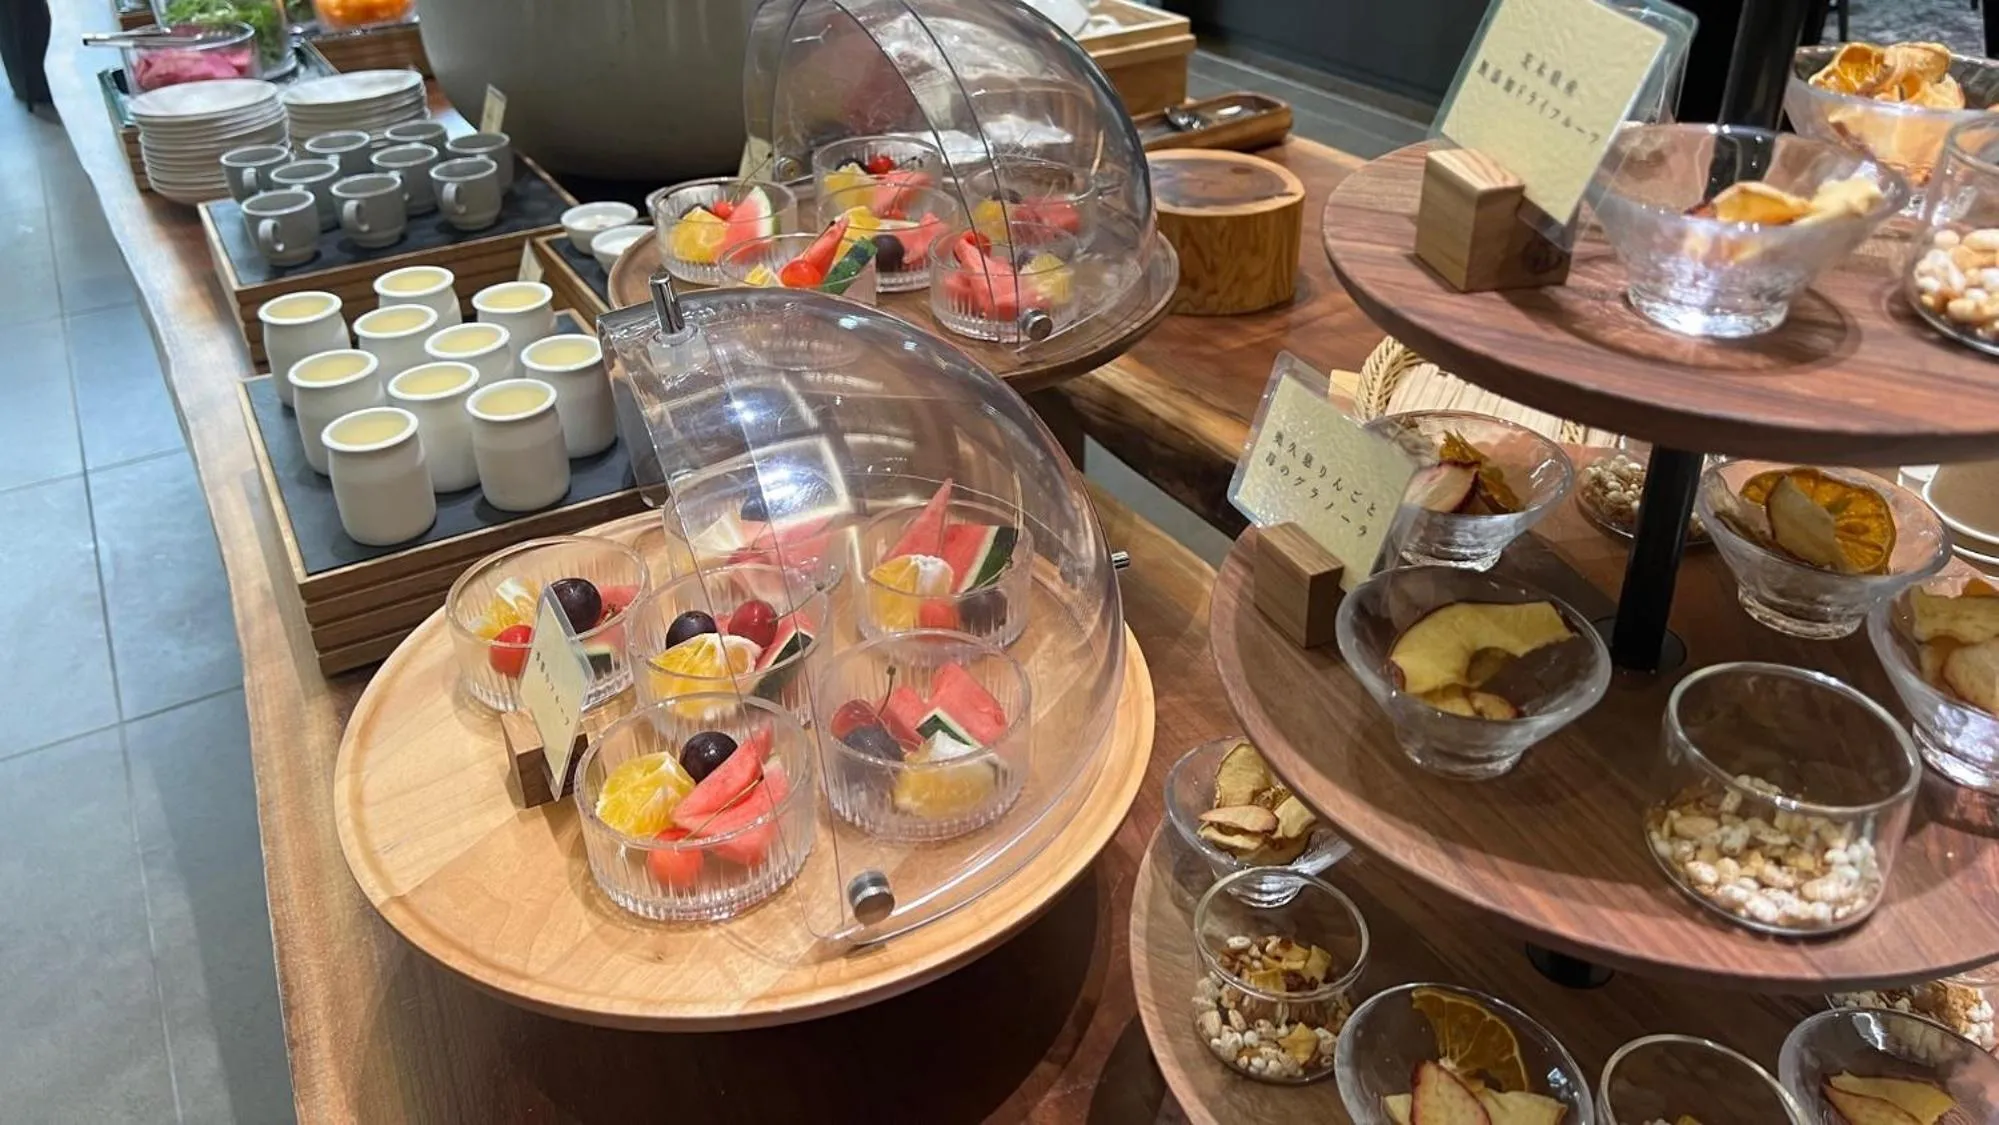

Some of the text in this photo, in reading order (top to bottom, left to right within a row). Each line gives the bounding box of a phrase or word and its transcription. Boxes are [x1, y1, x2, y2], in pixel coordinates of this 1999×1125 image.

[1273, 431, 1376, 518] 奥久慈りんごと
